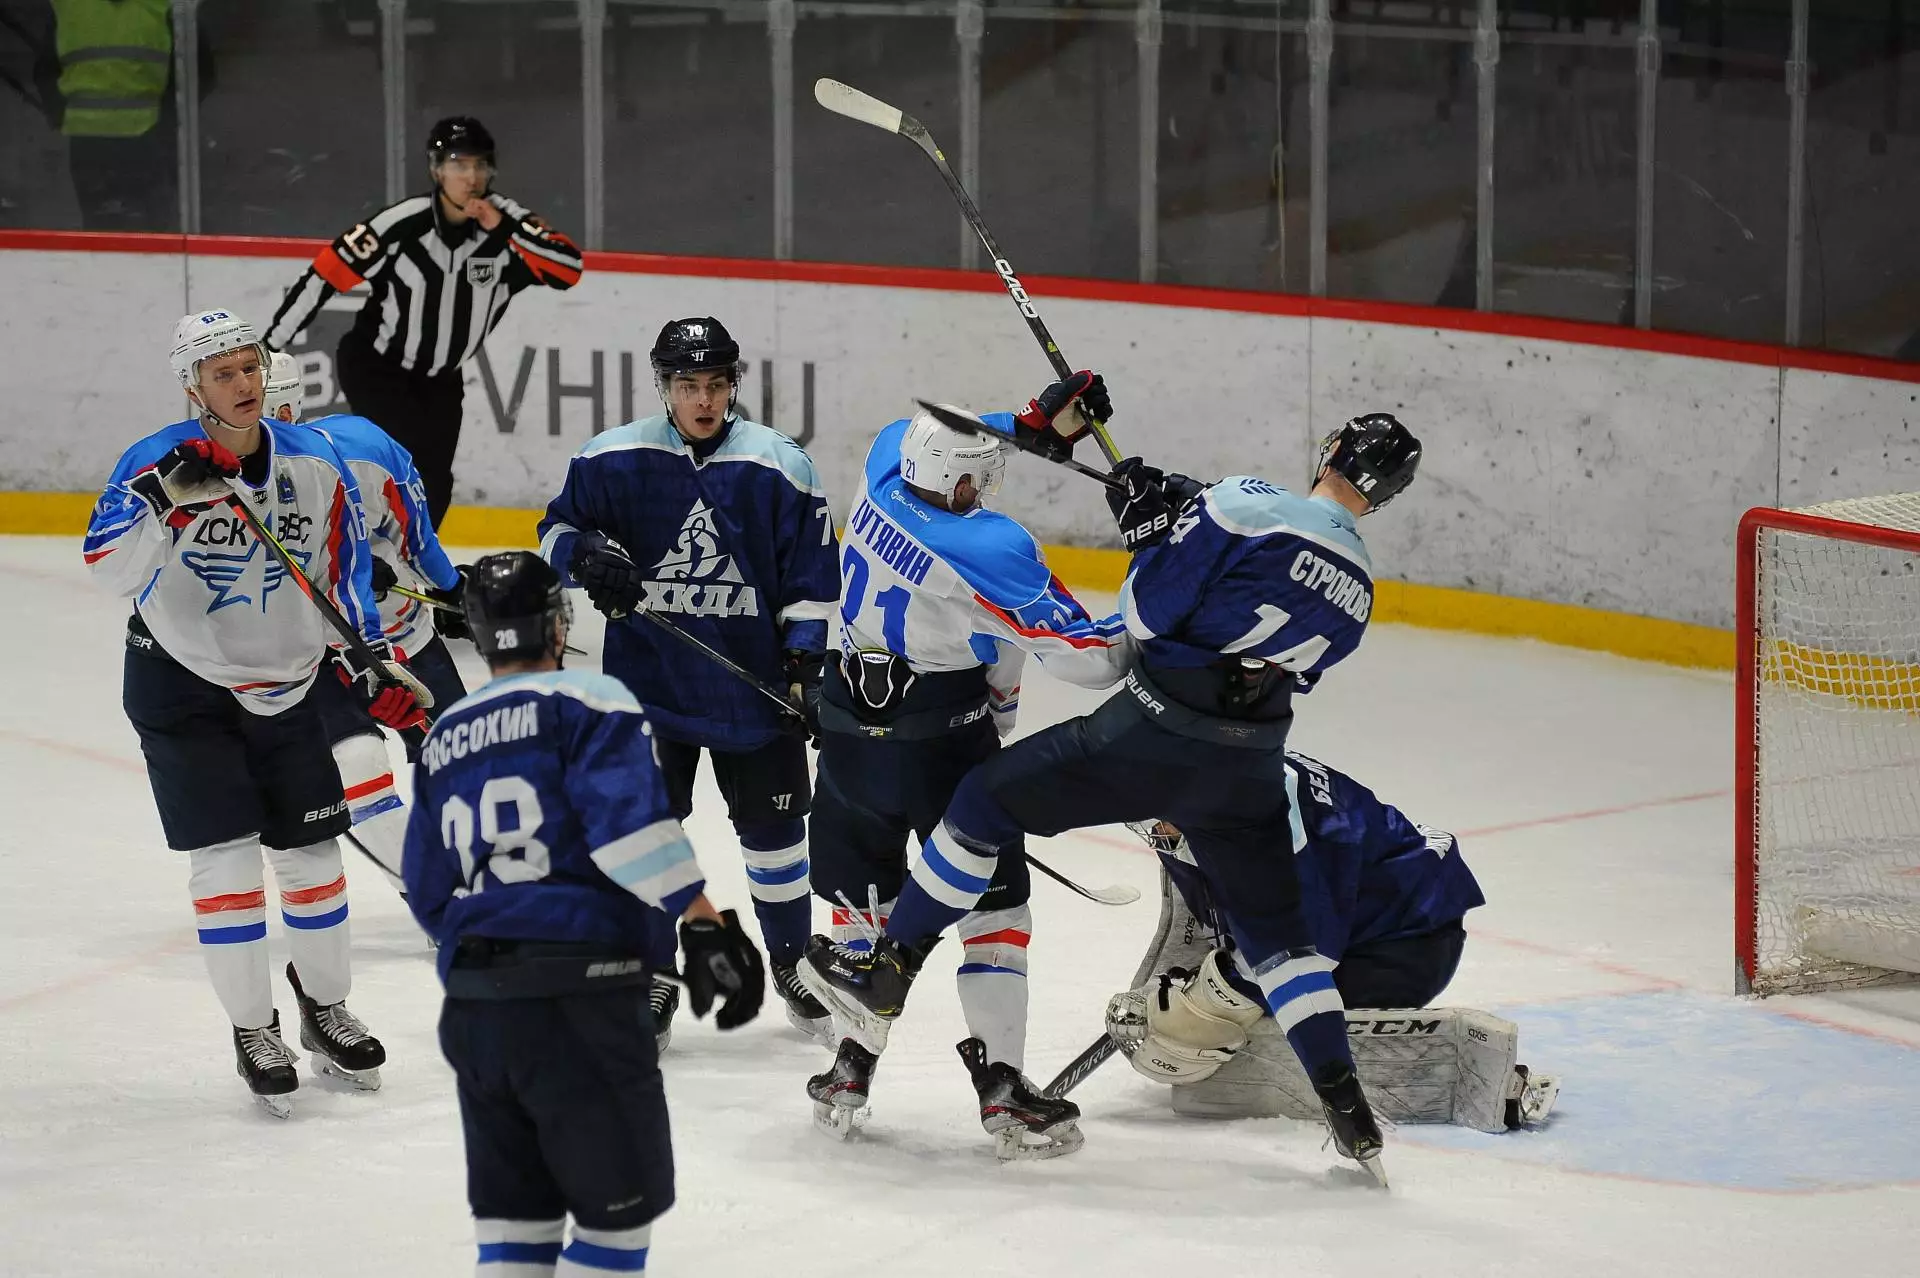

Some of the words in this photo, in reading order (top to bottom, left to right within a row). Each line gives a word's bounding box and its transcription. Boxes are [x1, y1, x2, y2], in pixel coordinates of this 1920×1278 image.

[343, 223, 379, 260] 13
[202, 312, 229, 324] 63
[686, 324, 704, 337] 70
[213, 326, 239, 338] BAUER
[905, 458, 916, 481] 21
[1356, 472, 1378, 493] 14
[1121, 512, 1169, 544] BAU
[1289, 550, 1372, 624] СТРОНОВ
[841, 543, 913, 664] 21
[495, 628, 518, 650] 28
[1218, 603, 1332, 673] 14
[1126, 667, 1165, 716] AUER
[949, 701, 991, 728] BAUE
[303, 800, 348, 823] BAUE
[441, 775, 551, 899] 28
[1184, 916, 1196, 946] AXIS
[1207, 977, 1240, 1007] CCM
[1345, 1019, 1442, 1035] CCM
[1468, 1028, 1488, 1042] AXIS
[1052, 1038, 1117, 1096] SUPRE
[1151, 1057, 1180, 1074] AXIS
